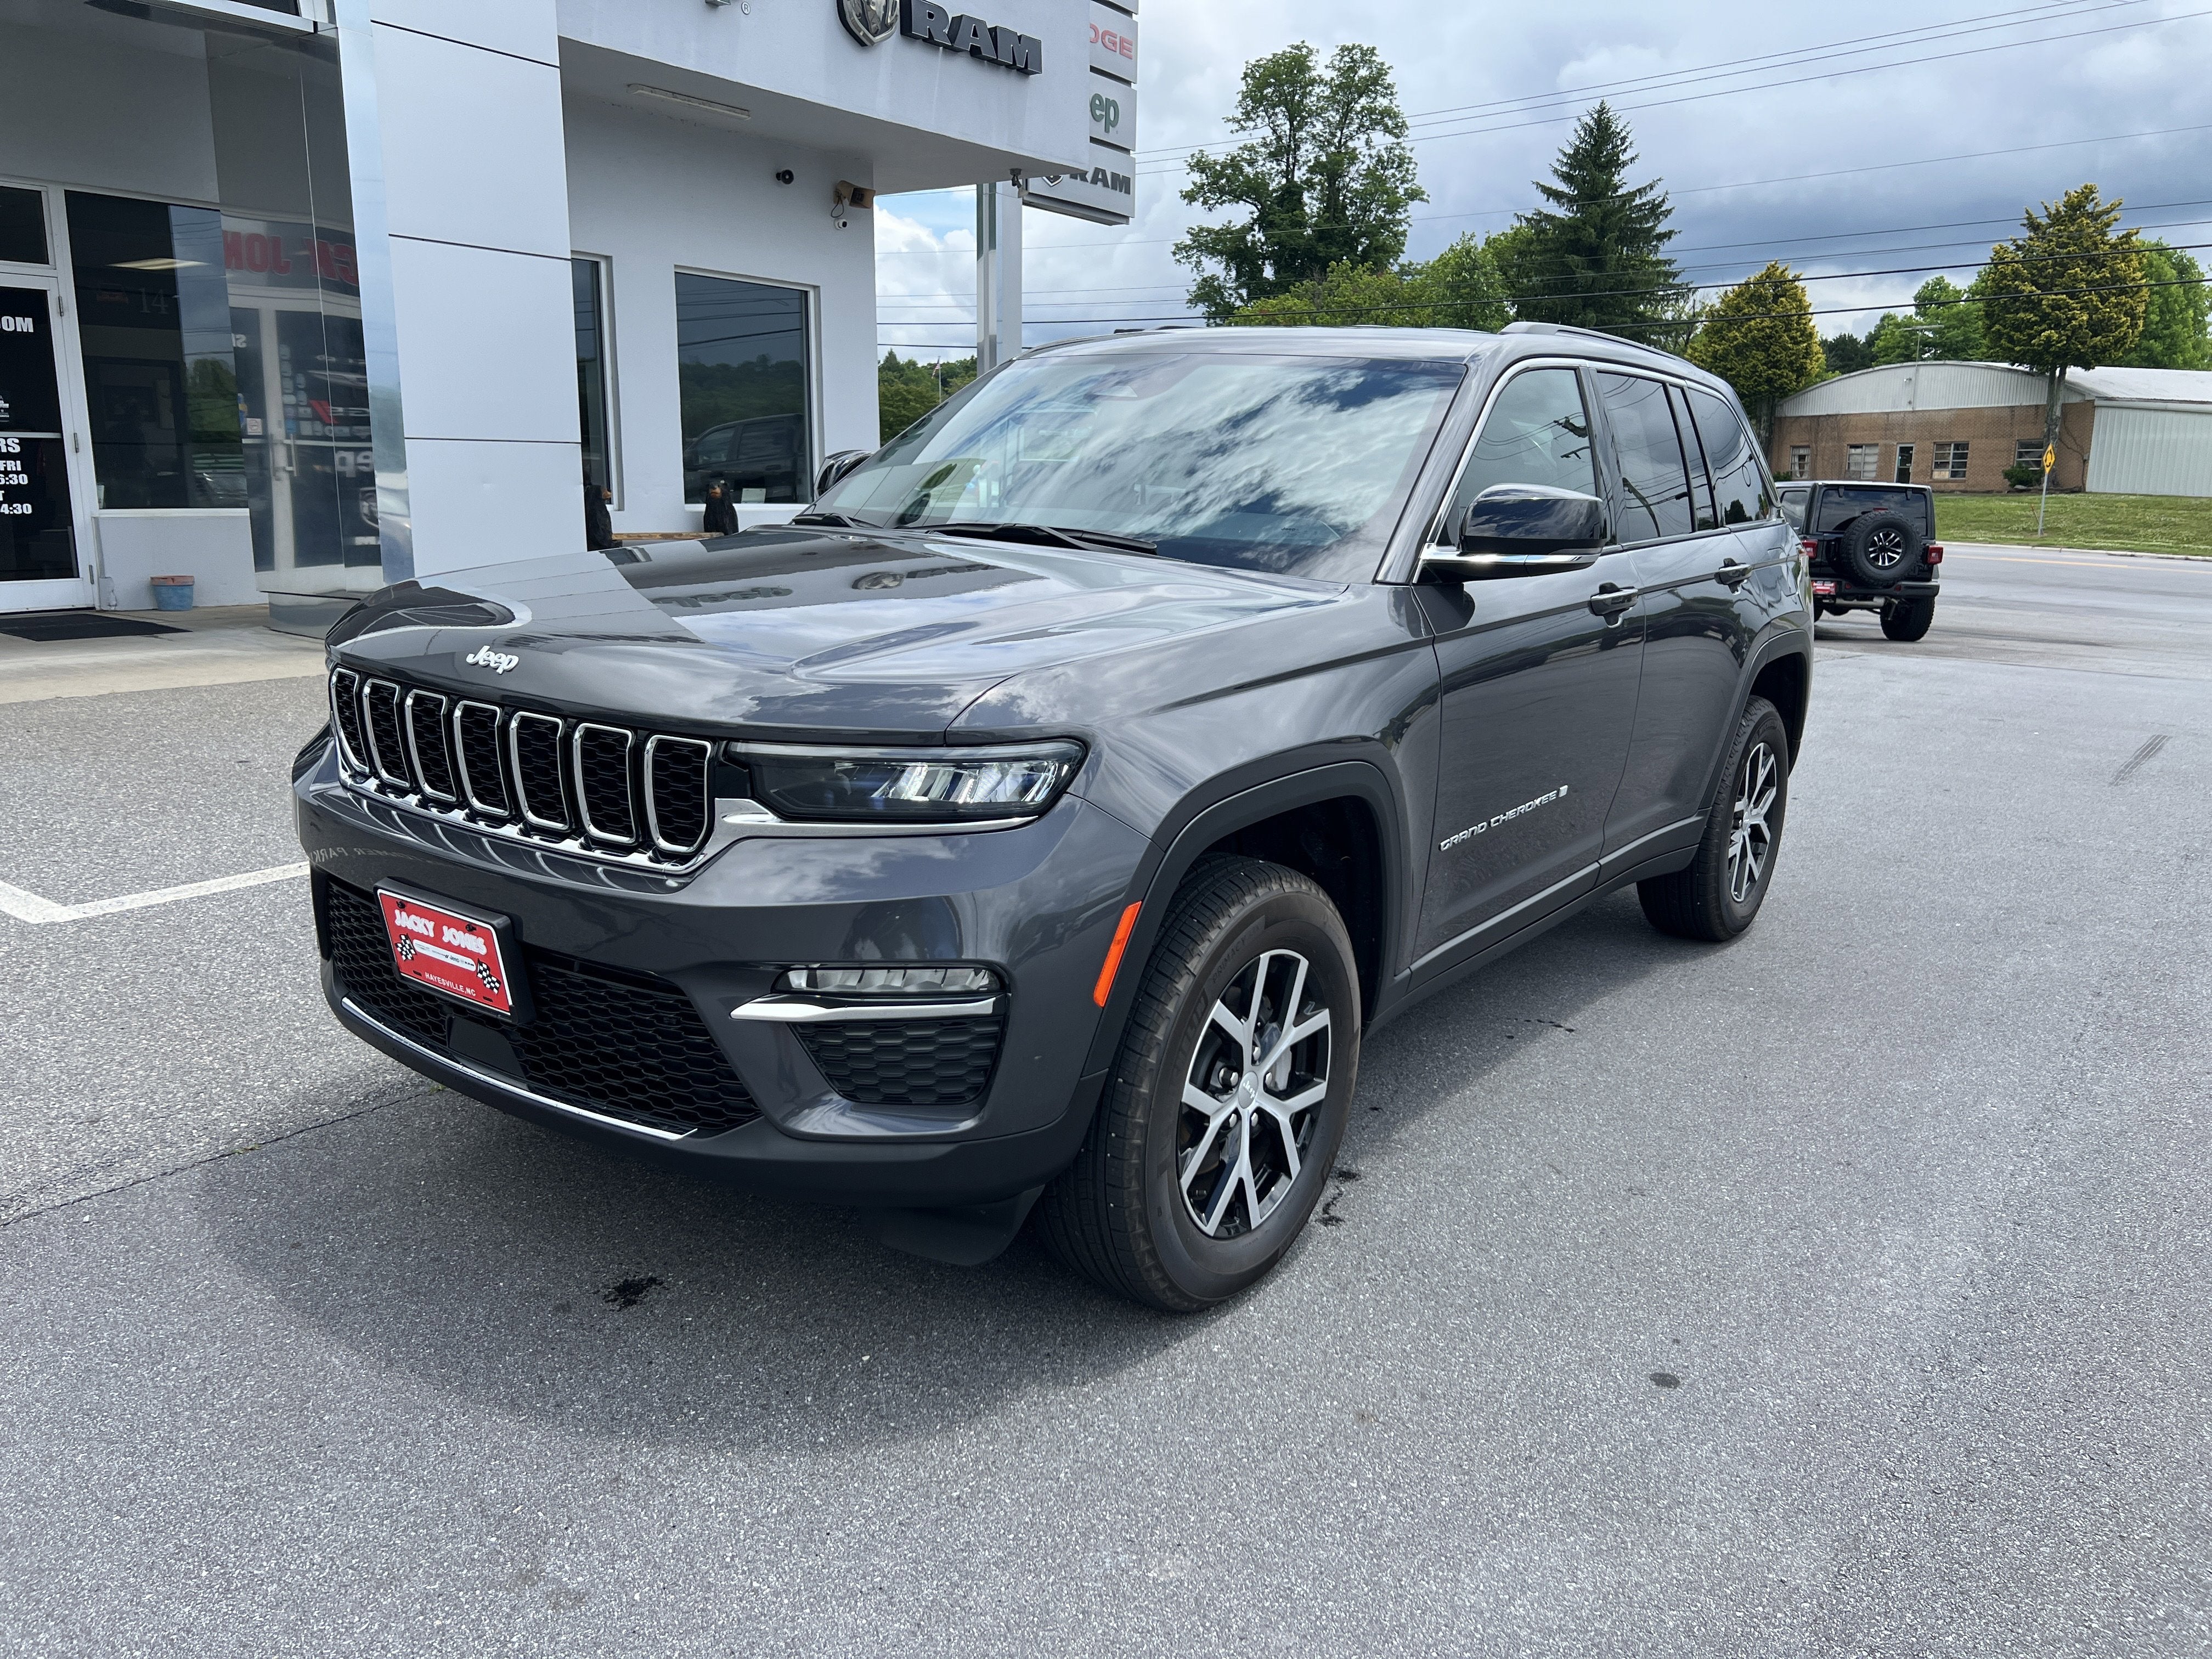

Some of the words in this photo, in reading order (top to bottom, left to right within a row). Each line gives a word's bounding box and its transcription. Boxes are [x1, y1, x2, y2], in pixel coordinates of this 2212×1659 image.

[900, 0, 1042, 75] RAM
[1090, 93, 1120, 133] ep
[0, 315, 34, 332] OM
[0, 460, 22, 471] FRI
[0, 503, 32, 515] 4:30
[466, 645, 520, 675] Jeep
[1439, 821, 1487, 851] GRAND
[1489, 790, 1558, 828] CHEROKEE
[394, 909, 435, 938] JACKY
[442, 925, 487, 956] JONES
